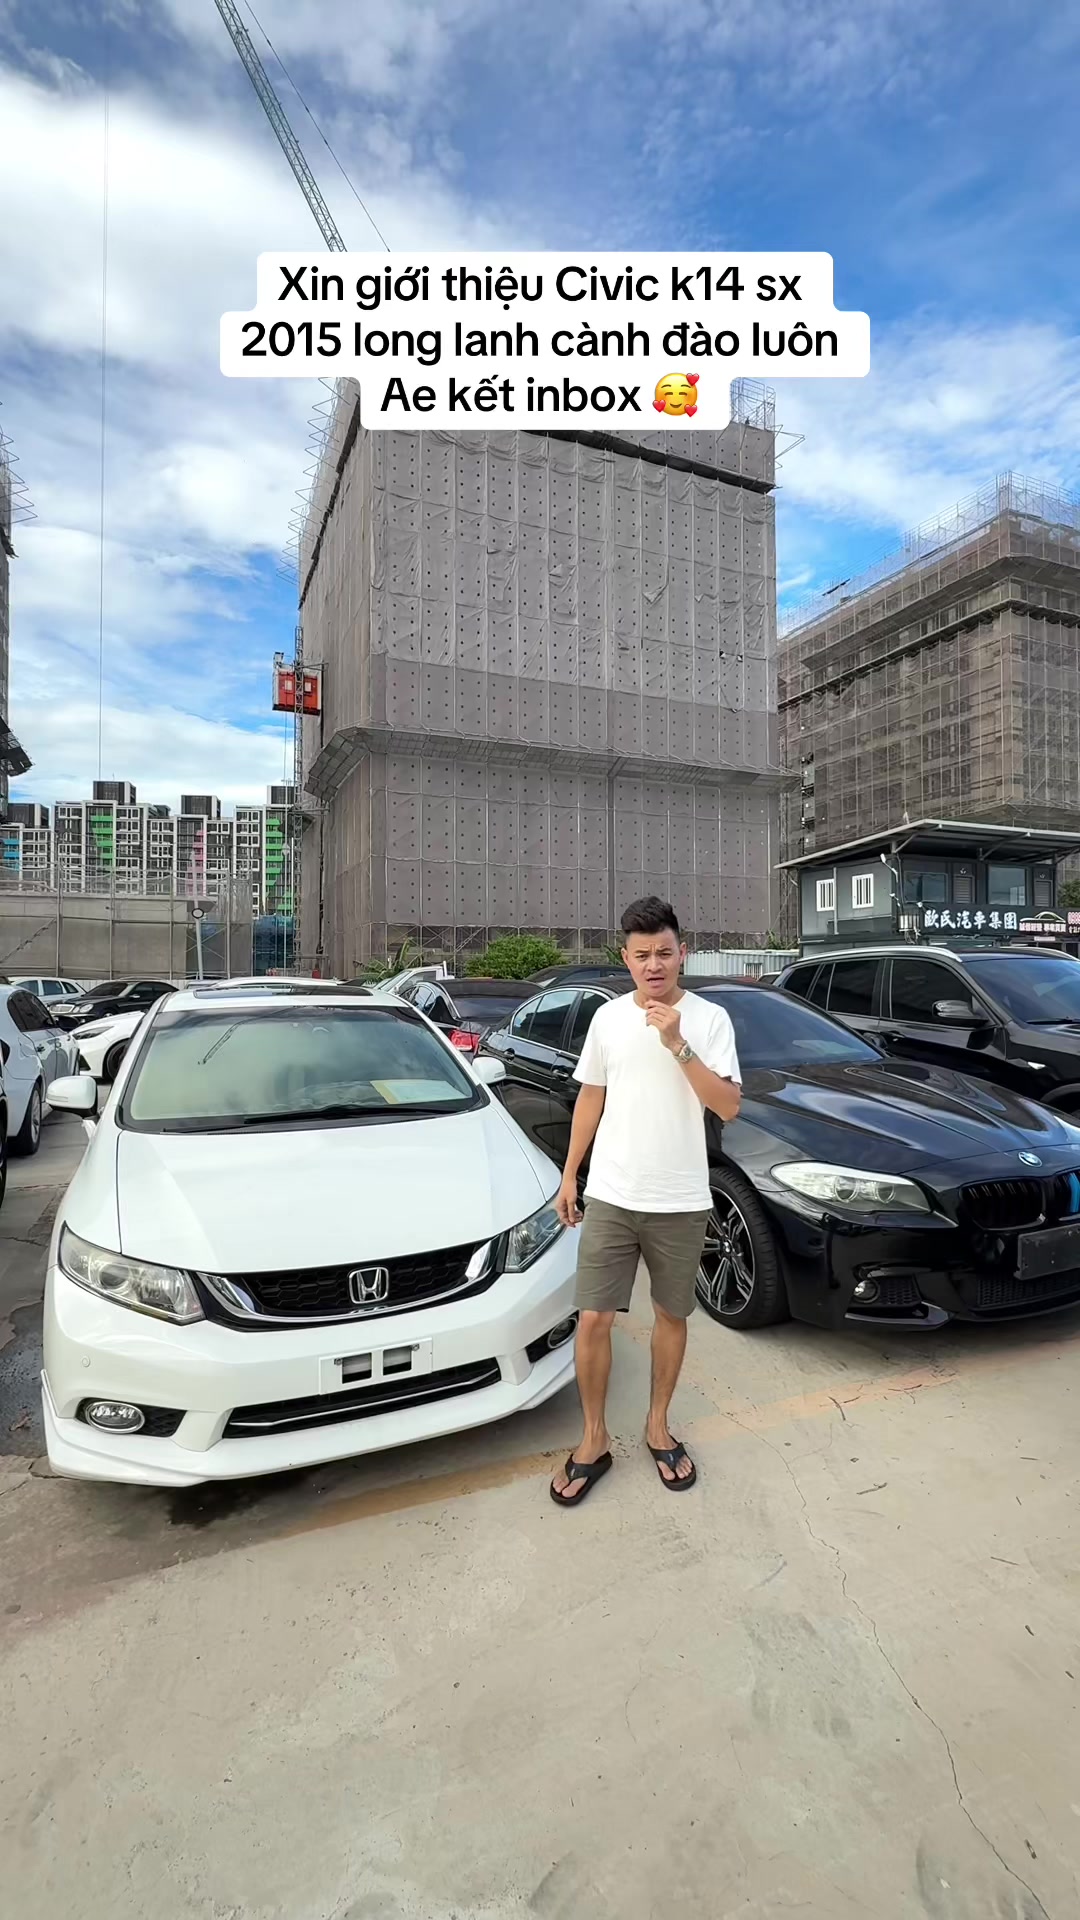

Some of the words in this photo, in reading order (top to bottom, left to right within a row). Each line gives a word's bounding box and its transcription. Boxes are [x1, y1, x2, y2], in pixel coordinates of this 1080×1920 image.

[924, 910, 1018, 930] 歐氏汽車集團
